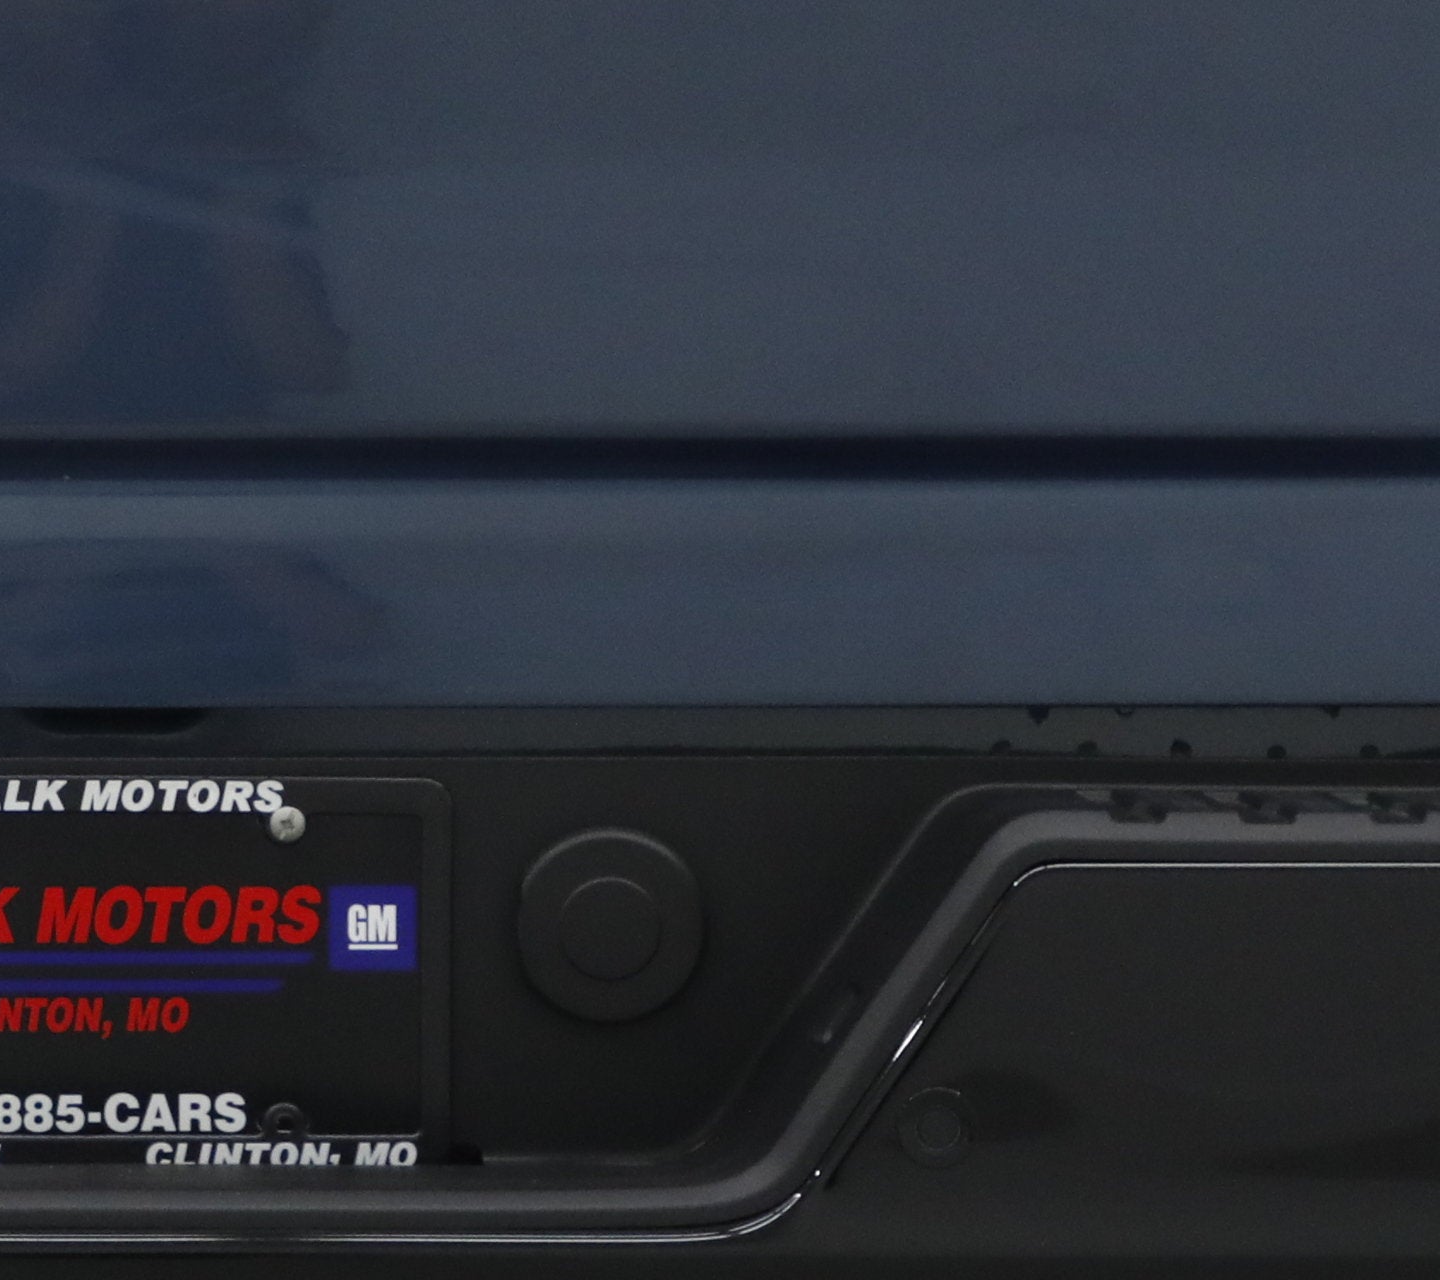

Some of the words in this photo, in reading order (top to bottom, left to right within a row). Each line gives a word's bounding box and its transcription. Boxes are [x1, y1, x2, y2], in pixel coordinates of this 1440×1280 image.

[80, 780, 284, 813] MOTORS
[36, 885, 321, 945] MOTORS
[347, 904, 398, 943] GM
[126, 997, 189, 1033] MO
[353, 1142, 417, 1167] MO
